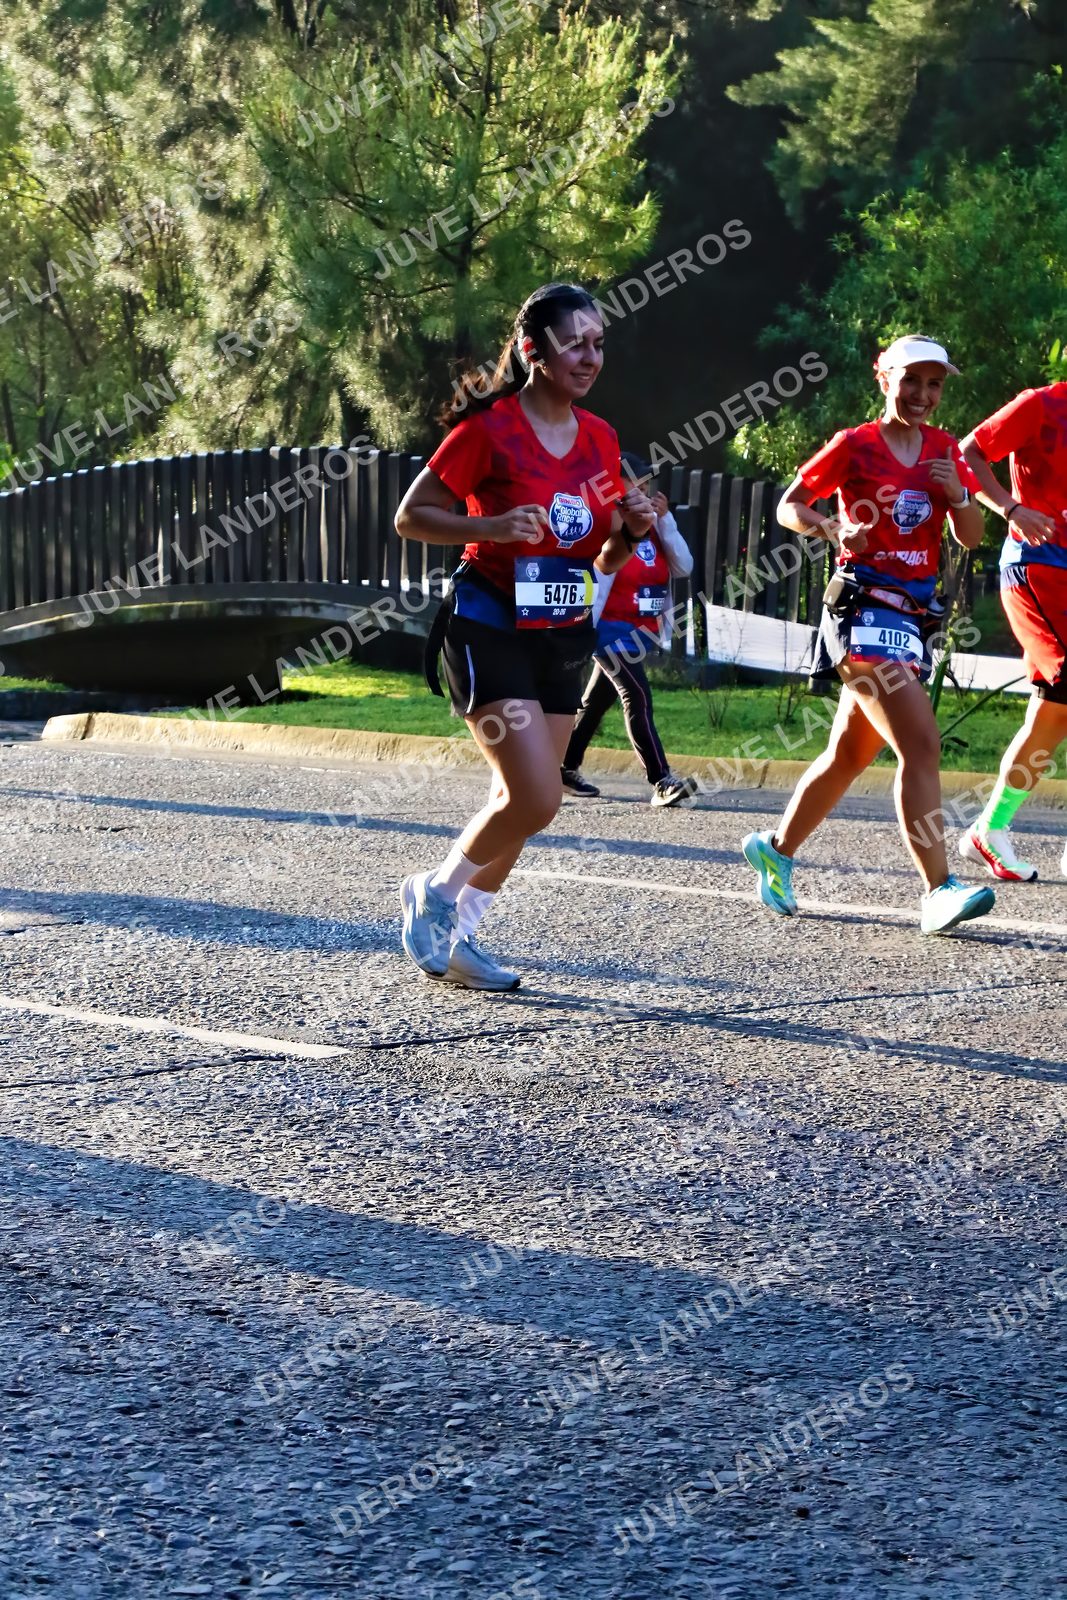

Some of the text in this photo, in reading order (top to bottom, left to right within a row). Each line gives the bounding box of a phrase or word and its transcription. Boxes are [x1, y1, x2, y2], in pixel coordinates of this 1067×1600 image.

[556, 512, 574, 523] Race
[560, 506, 582, 517] Global
[544, 584, 578, 605] 5476
[878, 629, 910, 649] 4102
